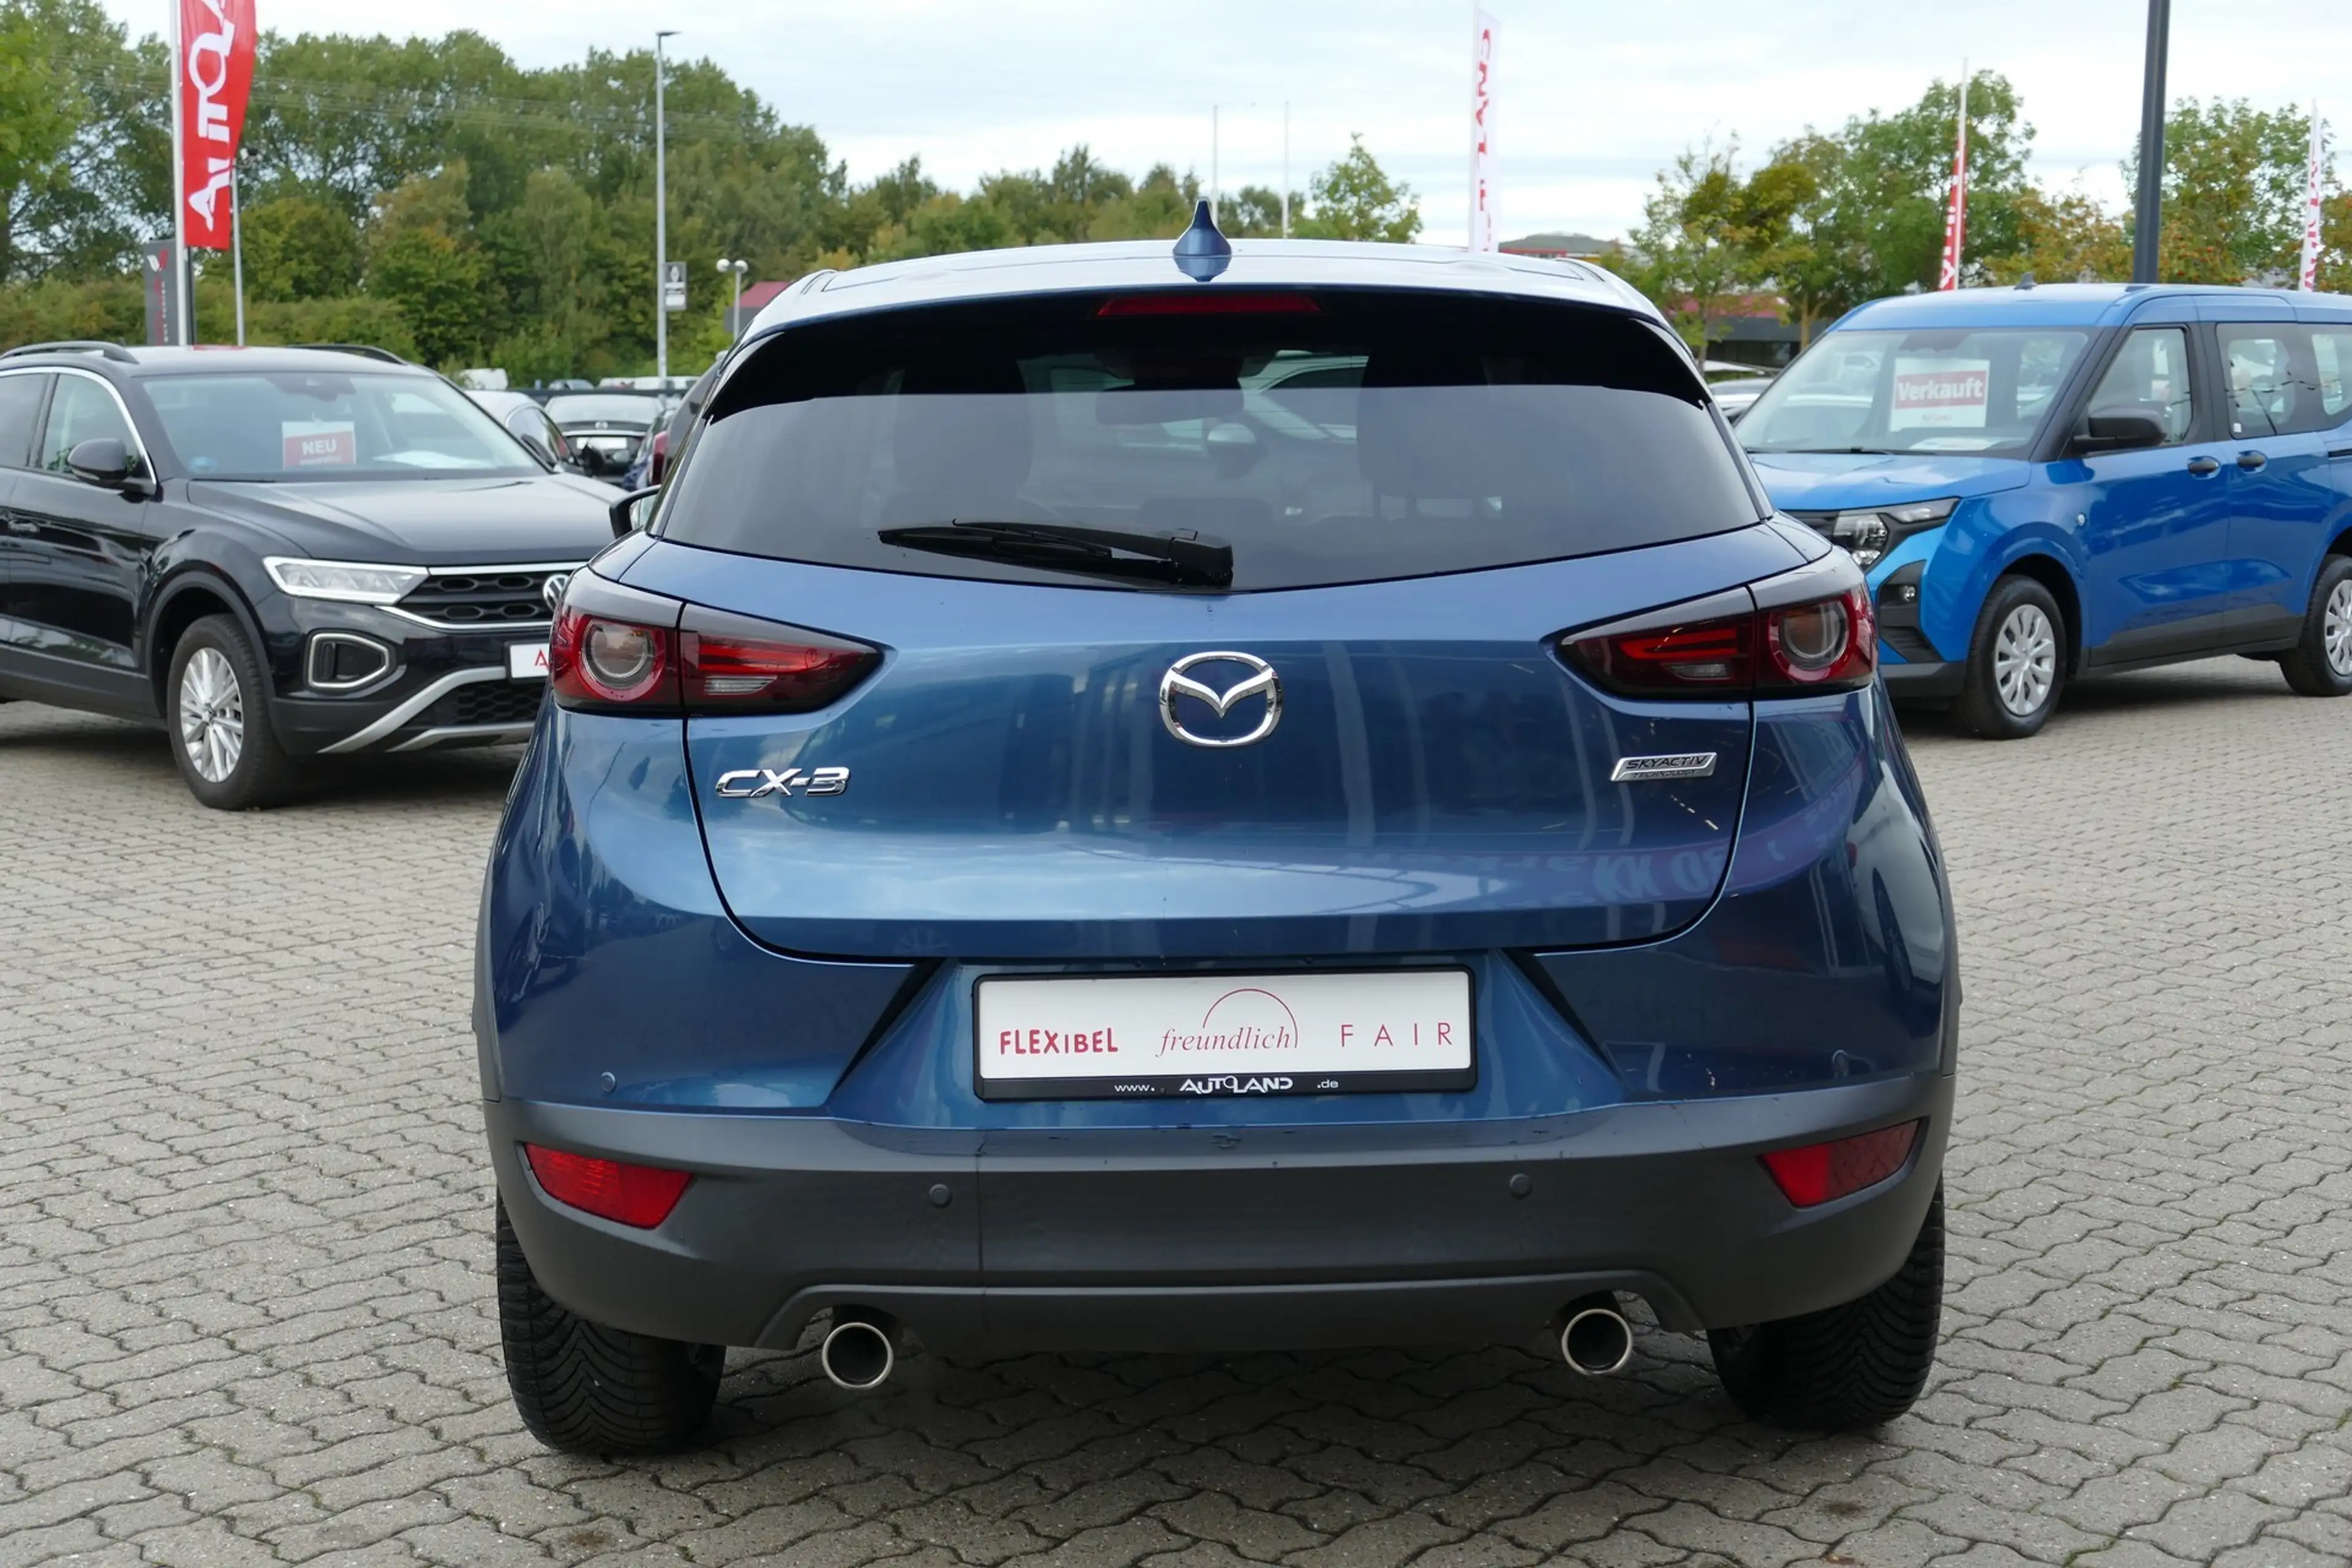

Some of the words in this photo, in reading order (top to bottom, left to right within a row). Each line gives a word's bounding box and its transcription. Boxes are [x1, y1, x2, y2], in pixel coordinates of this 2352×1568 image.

[1898, 377, 1983, 400] Verkauft
[302, 439, 336, 455] NEU
[1626, 756, 1706, 769] SKYACTIV
[1634, 769, 1697, 778] TECHNOLOGY
[715, 767, 850, 797] CX-3
[1000, 1028, 1118, 1055] FLEXIBEL
[1156, 1026, 1290, 1057] freundlich
[1340, 1022, 1453, 1048] FAIR
[1115, 1084, 1155, 1093] www.
[1317, 1079, 1339, 1088] .de
